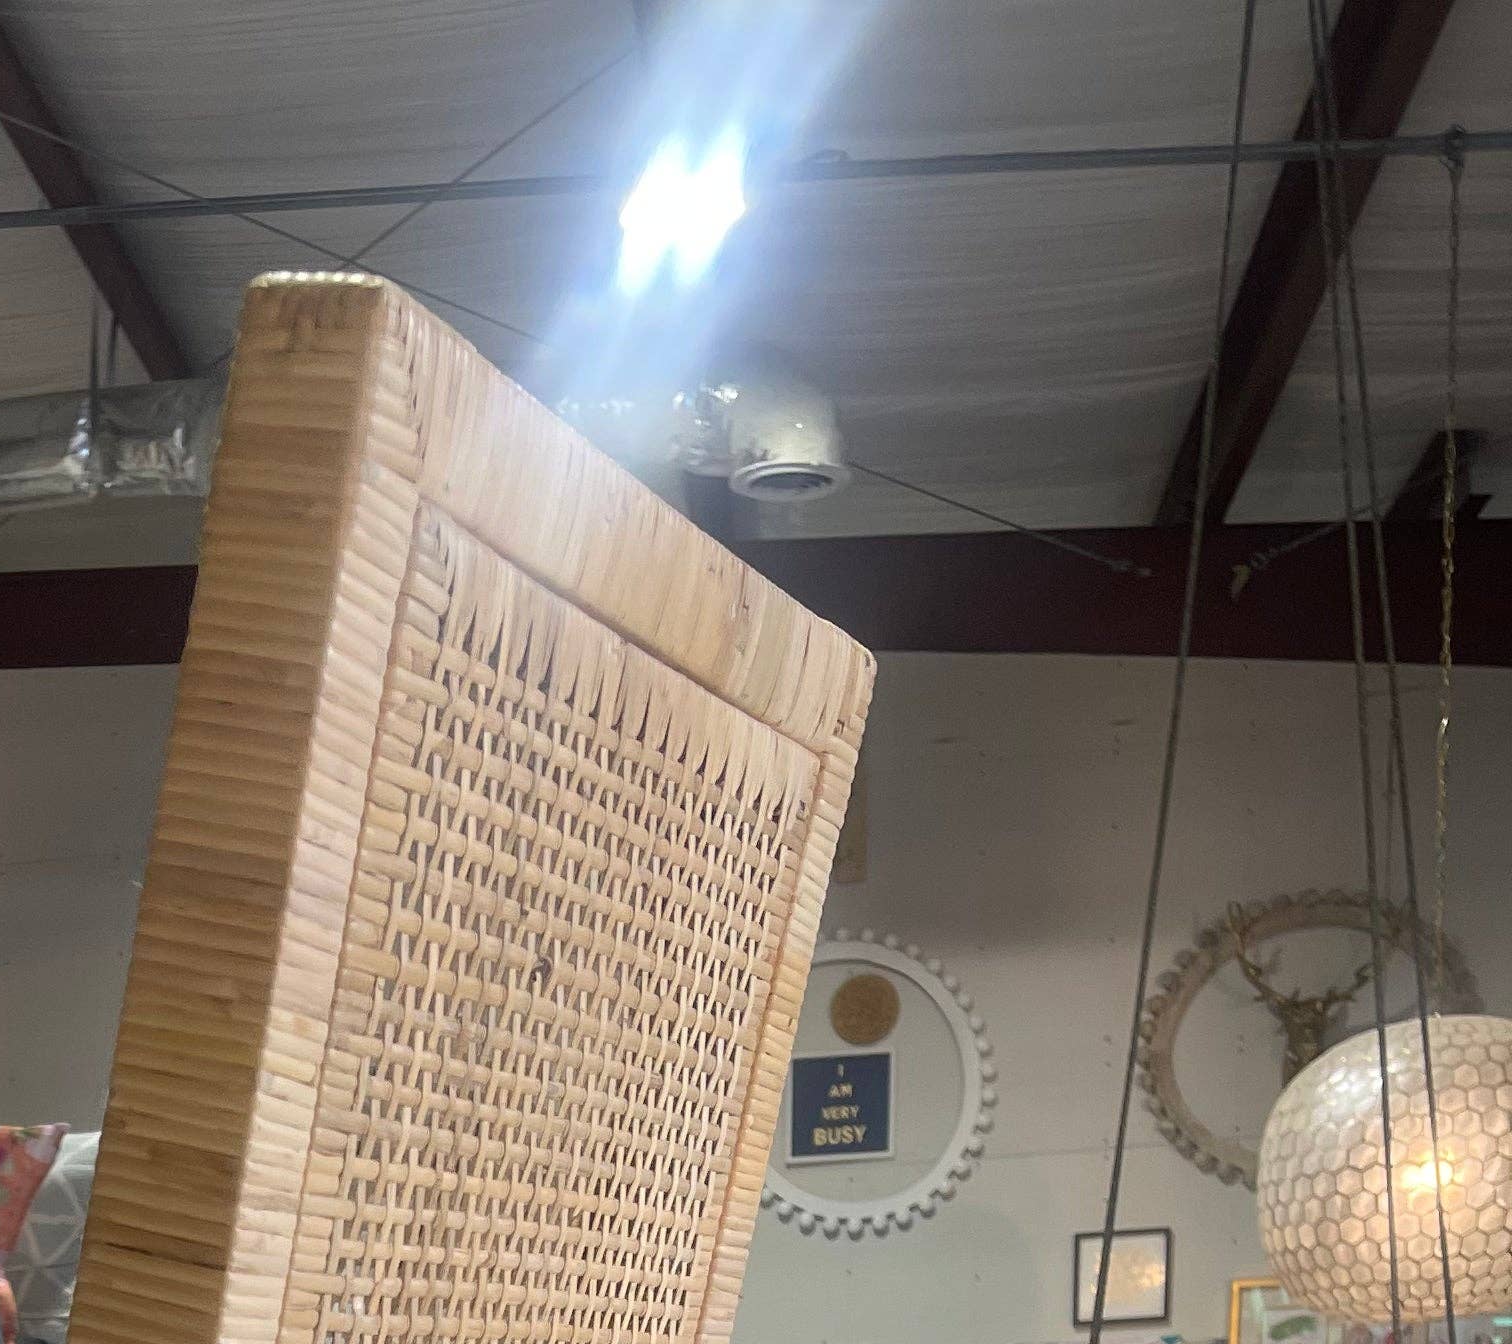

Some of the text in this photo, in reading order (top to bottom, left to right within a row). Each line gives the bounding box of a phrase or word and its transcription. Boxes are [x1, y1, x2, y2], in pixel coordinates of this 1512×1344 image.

[827, 1083, 854, 1098] AM
[821, 1105, 860, 1120] VERY
[812, 1124, 868, 1146] BUSY
